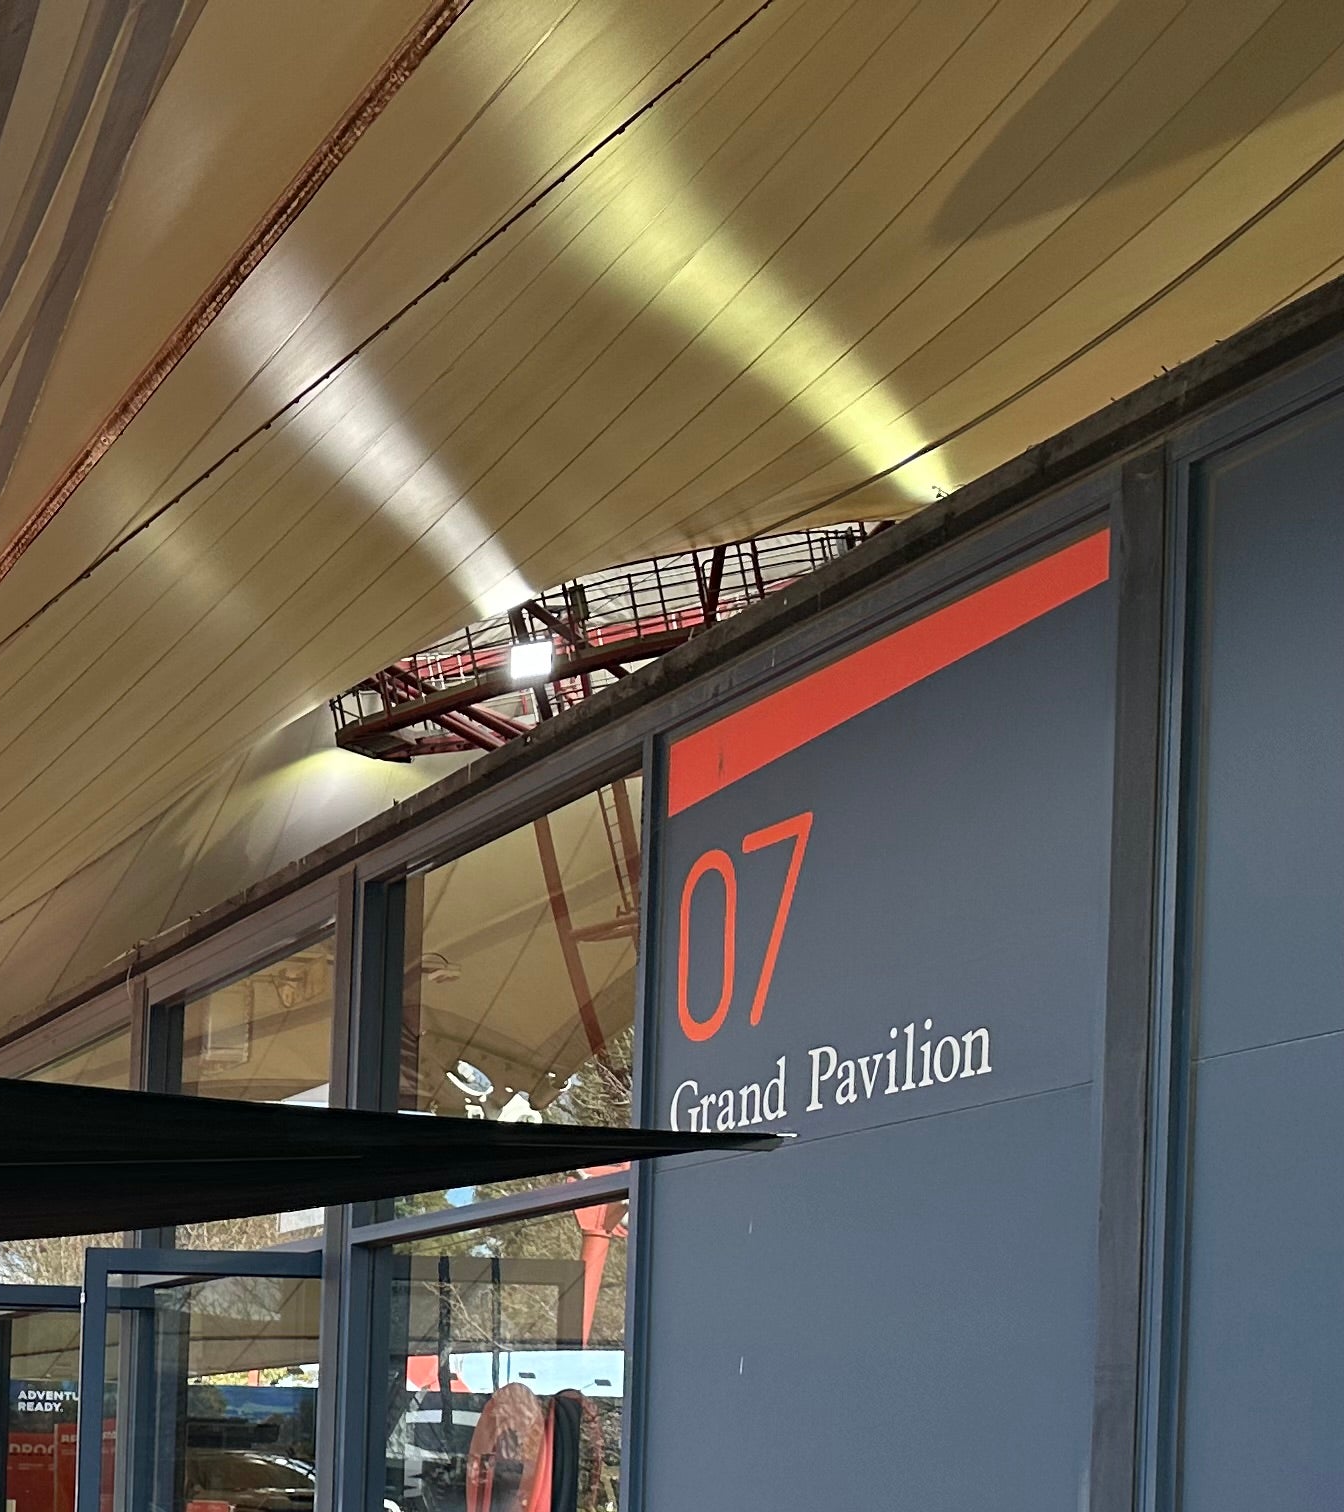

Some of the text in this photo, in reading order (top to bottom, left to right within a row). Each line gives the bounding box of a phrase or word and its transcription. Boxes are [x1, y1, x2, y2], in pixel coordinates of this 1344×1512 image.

[677, 811, 813, 1042] 07
[670, 1018, 993, 1134] Grand Pavilion
[17, 1402, 64, 1412] READY.
